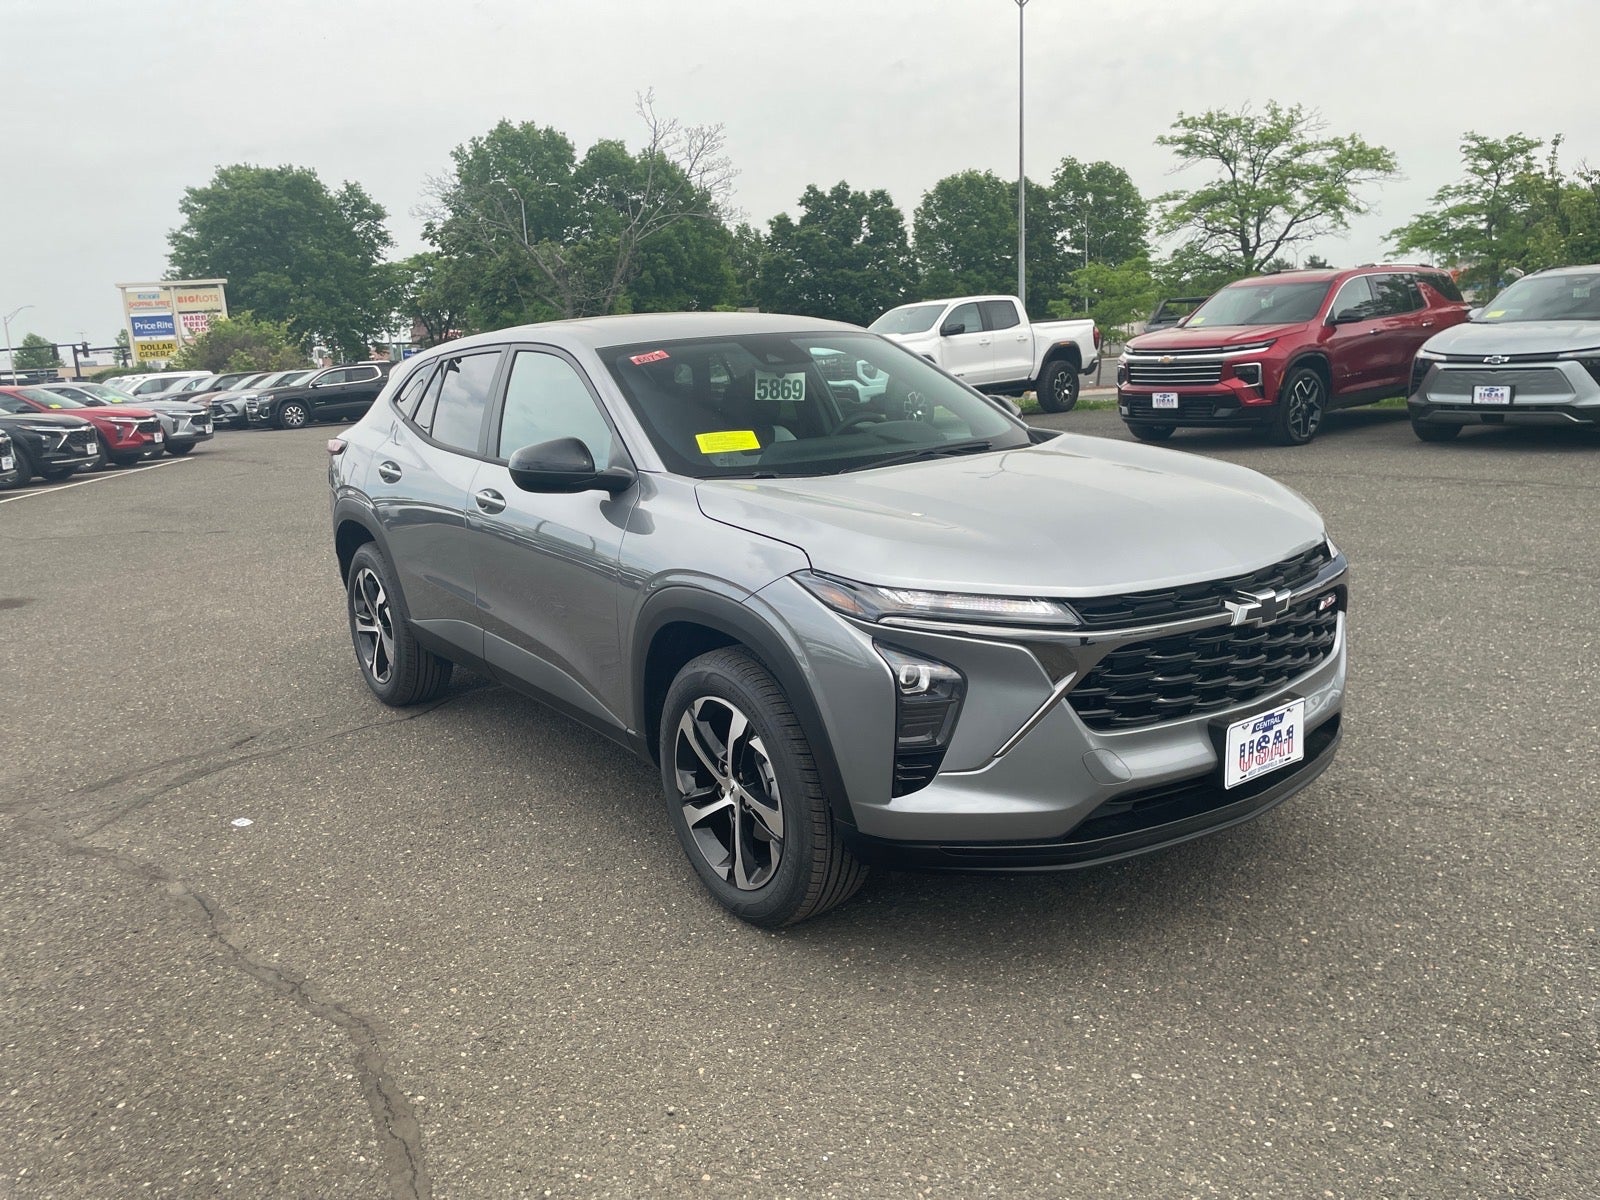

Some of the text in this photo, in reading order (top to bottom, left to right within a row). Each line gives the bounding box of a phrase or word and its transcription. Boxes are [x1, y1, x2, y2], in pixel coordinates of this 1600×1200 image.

[134, 321, 173, 330] Price Rite
[756, 378, 804, 400] 5869
[1255, 715, 1281, 731] CENTRAL
